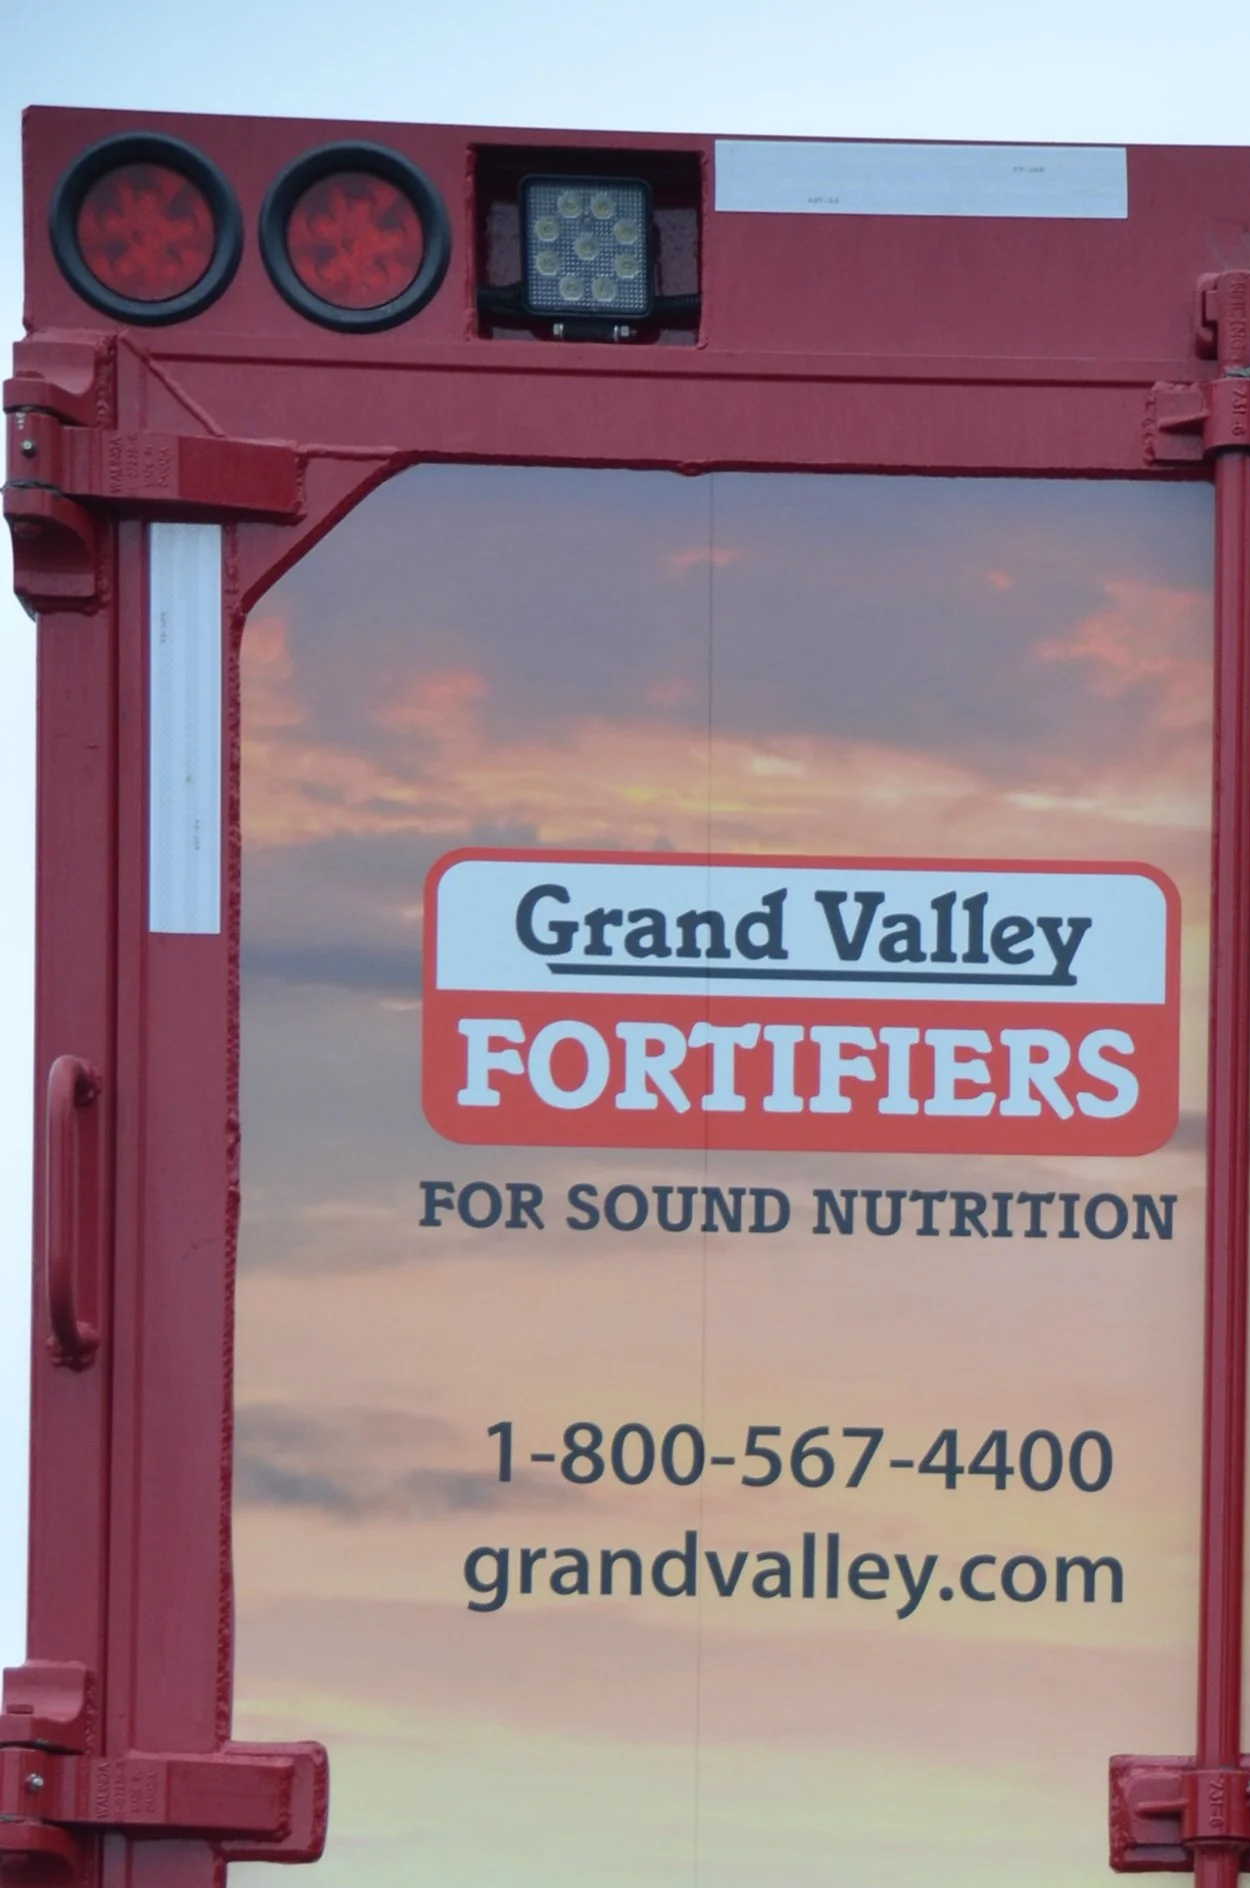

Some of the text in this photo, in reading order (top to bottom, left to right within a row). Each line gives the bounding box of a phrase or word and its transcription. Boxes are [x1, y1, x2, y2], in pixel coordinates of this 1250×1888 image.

[515, 883, 1092, 986] Grand Valley
[456, 1017, 1140, 1120] FORTIFIERS
[419, 1181, 1178, 1240] FOR SOUND NUTRITION
[486, 1420, 1114, 1493] 1-800-567-4400
[463, 1529, 1124, 1620] grandvalley.com
